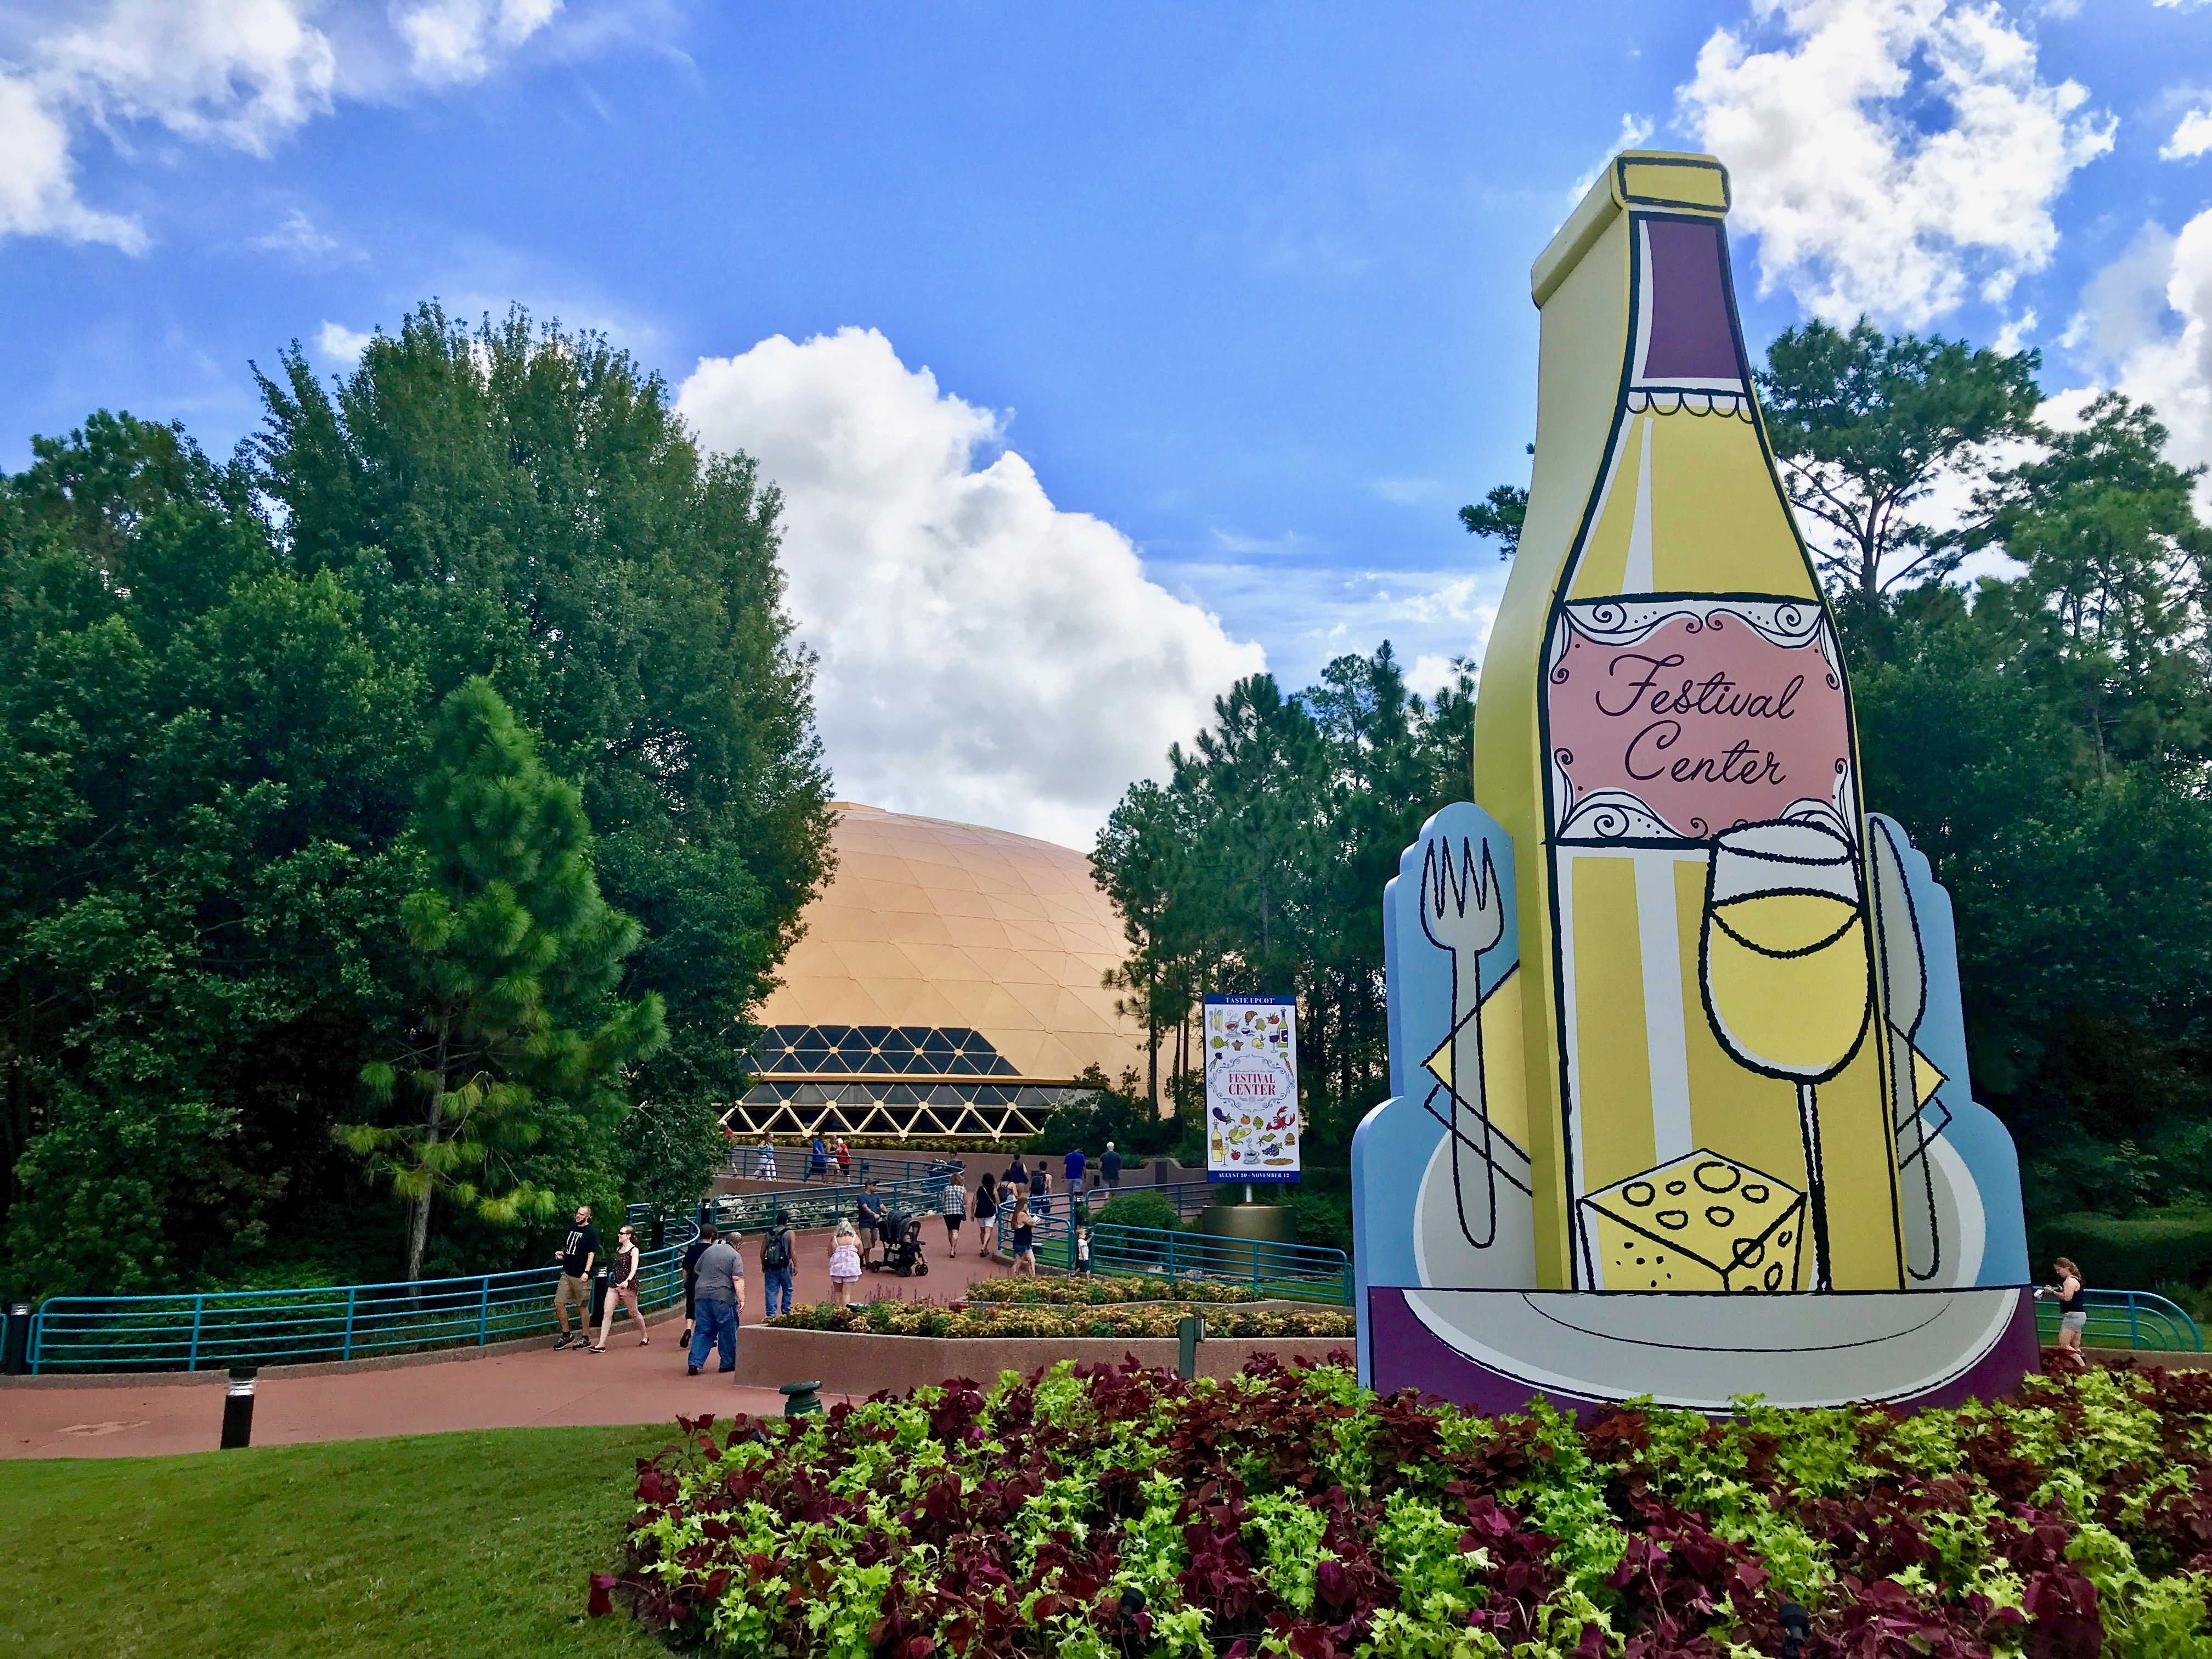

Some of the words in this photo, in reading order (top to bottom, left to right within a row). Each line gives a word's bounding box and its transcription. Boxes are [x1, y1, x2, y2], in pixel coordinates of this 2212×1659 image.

[1595, 654, 1804, 719] Festival
[1624, 720, 1786, 785] Center
[1228, 1084, 1276, 1096] CENTER
[1229, 1073, 1276, 1084] FESTIVAL
